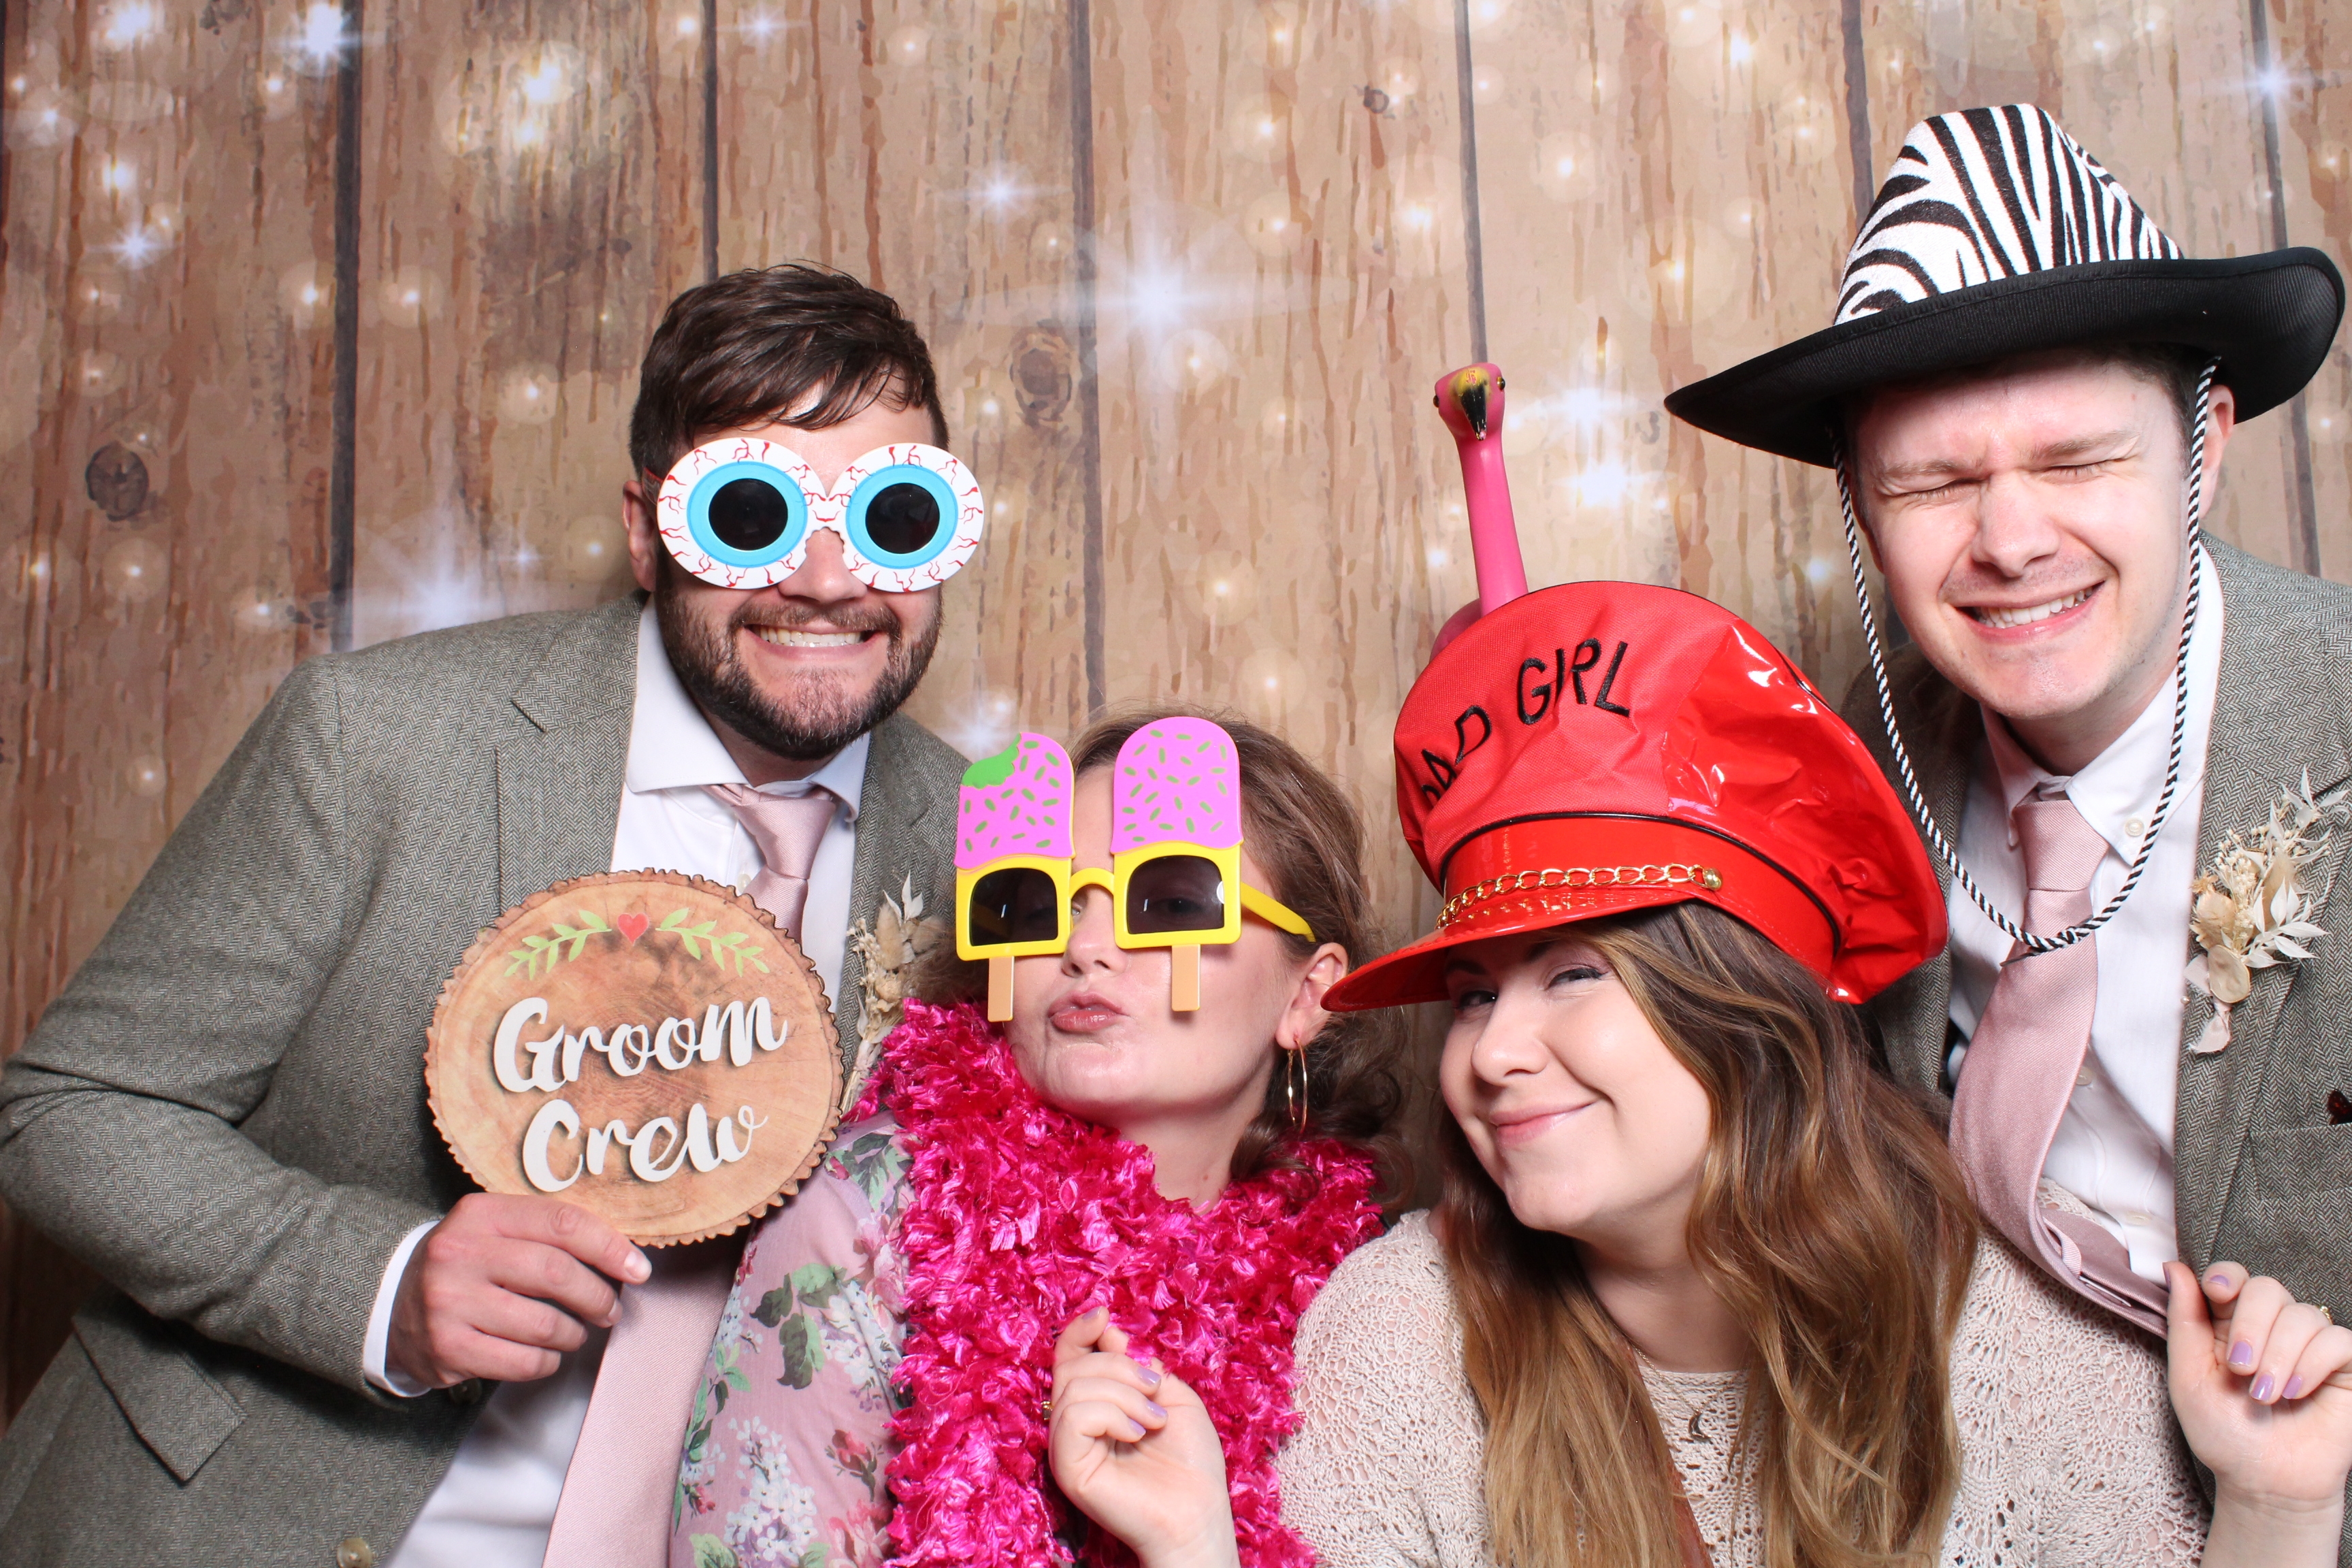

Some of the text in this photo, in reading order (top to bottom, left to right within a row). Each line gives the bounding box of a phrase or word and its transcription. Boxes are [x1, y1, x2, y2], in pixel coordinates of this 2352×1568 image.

[1516, 638, 1629, 725] GIRL
[493, 996, 788, 1092] Groom
[523, 1099, 768, 1192] Crew
